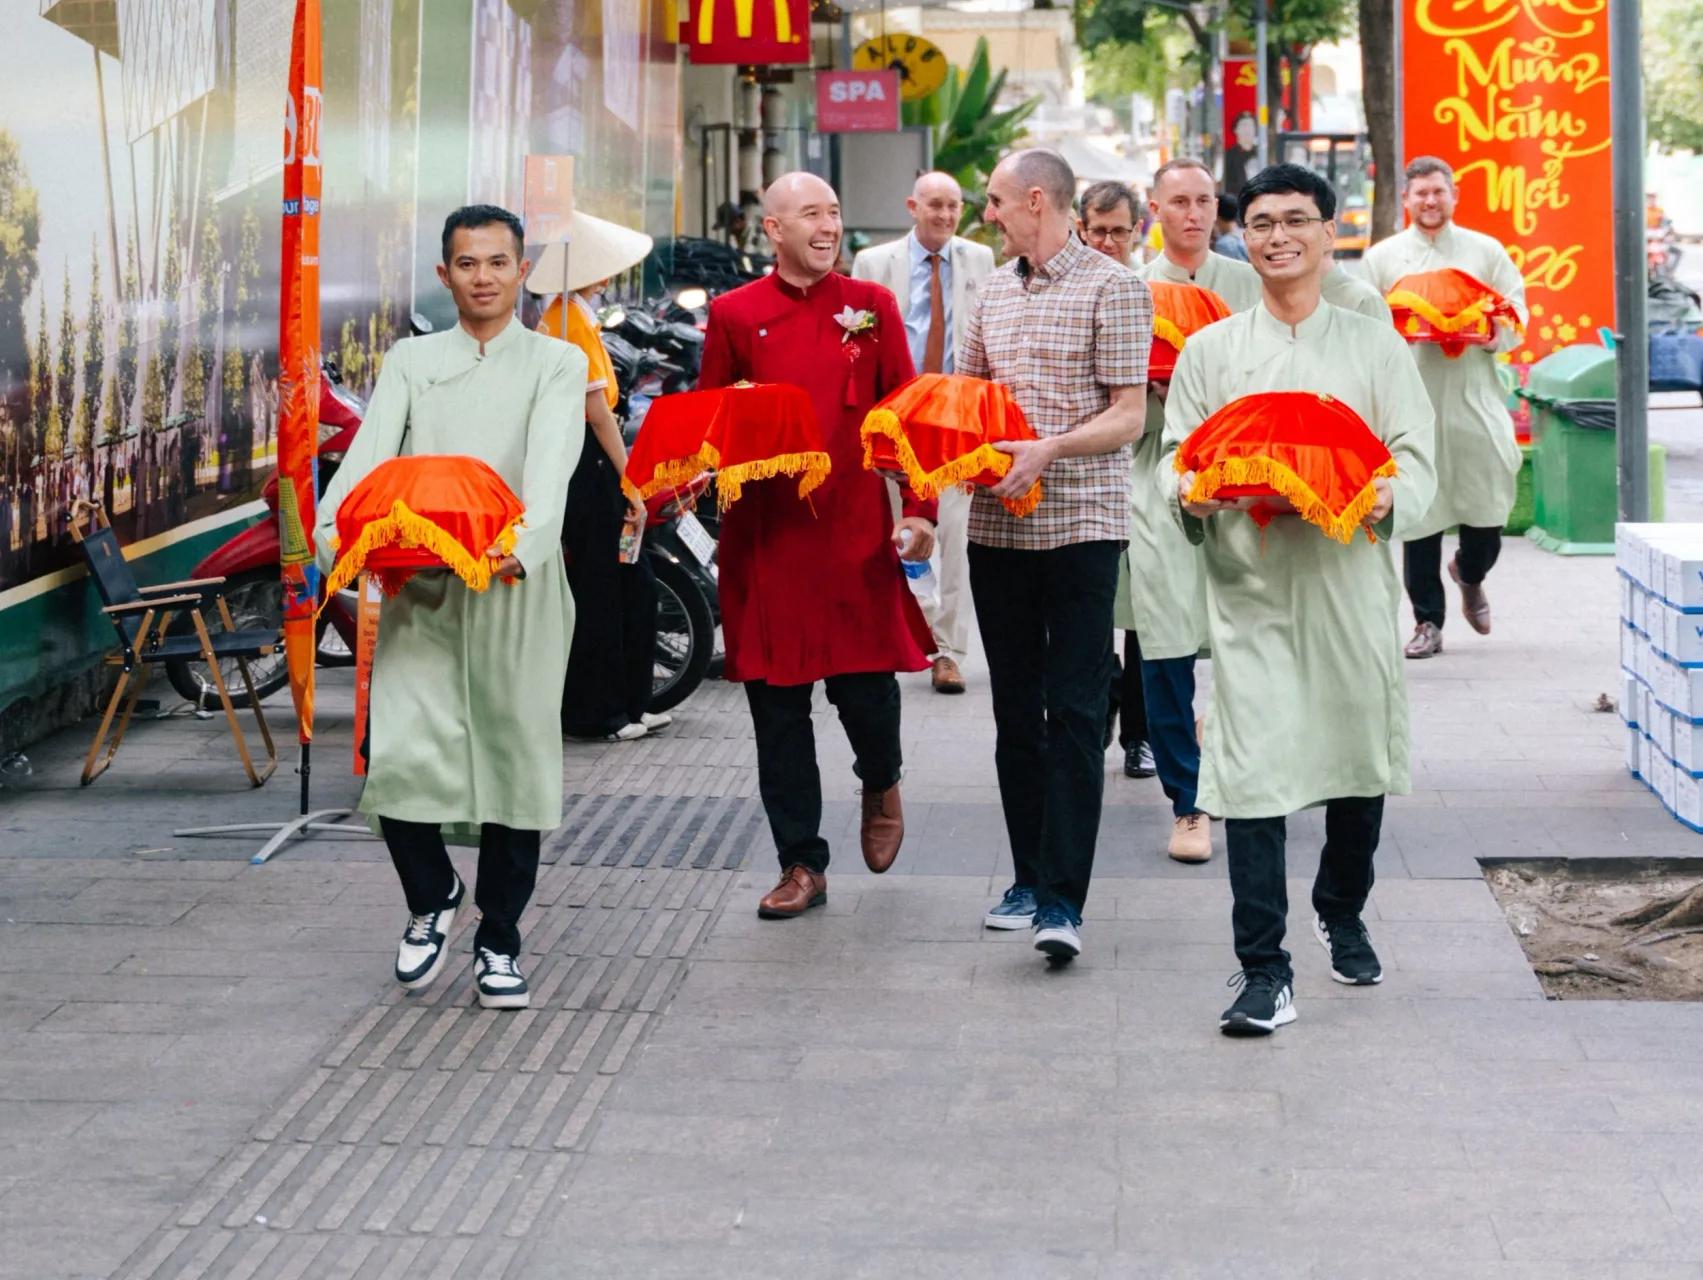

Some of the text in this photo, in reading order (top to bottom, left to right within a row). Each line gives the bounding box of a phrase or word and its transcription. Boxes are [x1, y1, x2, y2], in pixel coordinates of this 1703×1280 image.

[829, 80, 885, 102] SPA
[1434, 83, 1587, 152] Năm
[1453, 139, 1611, 236] Mới
